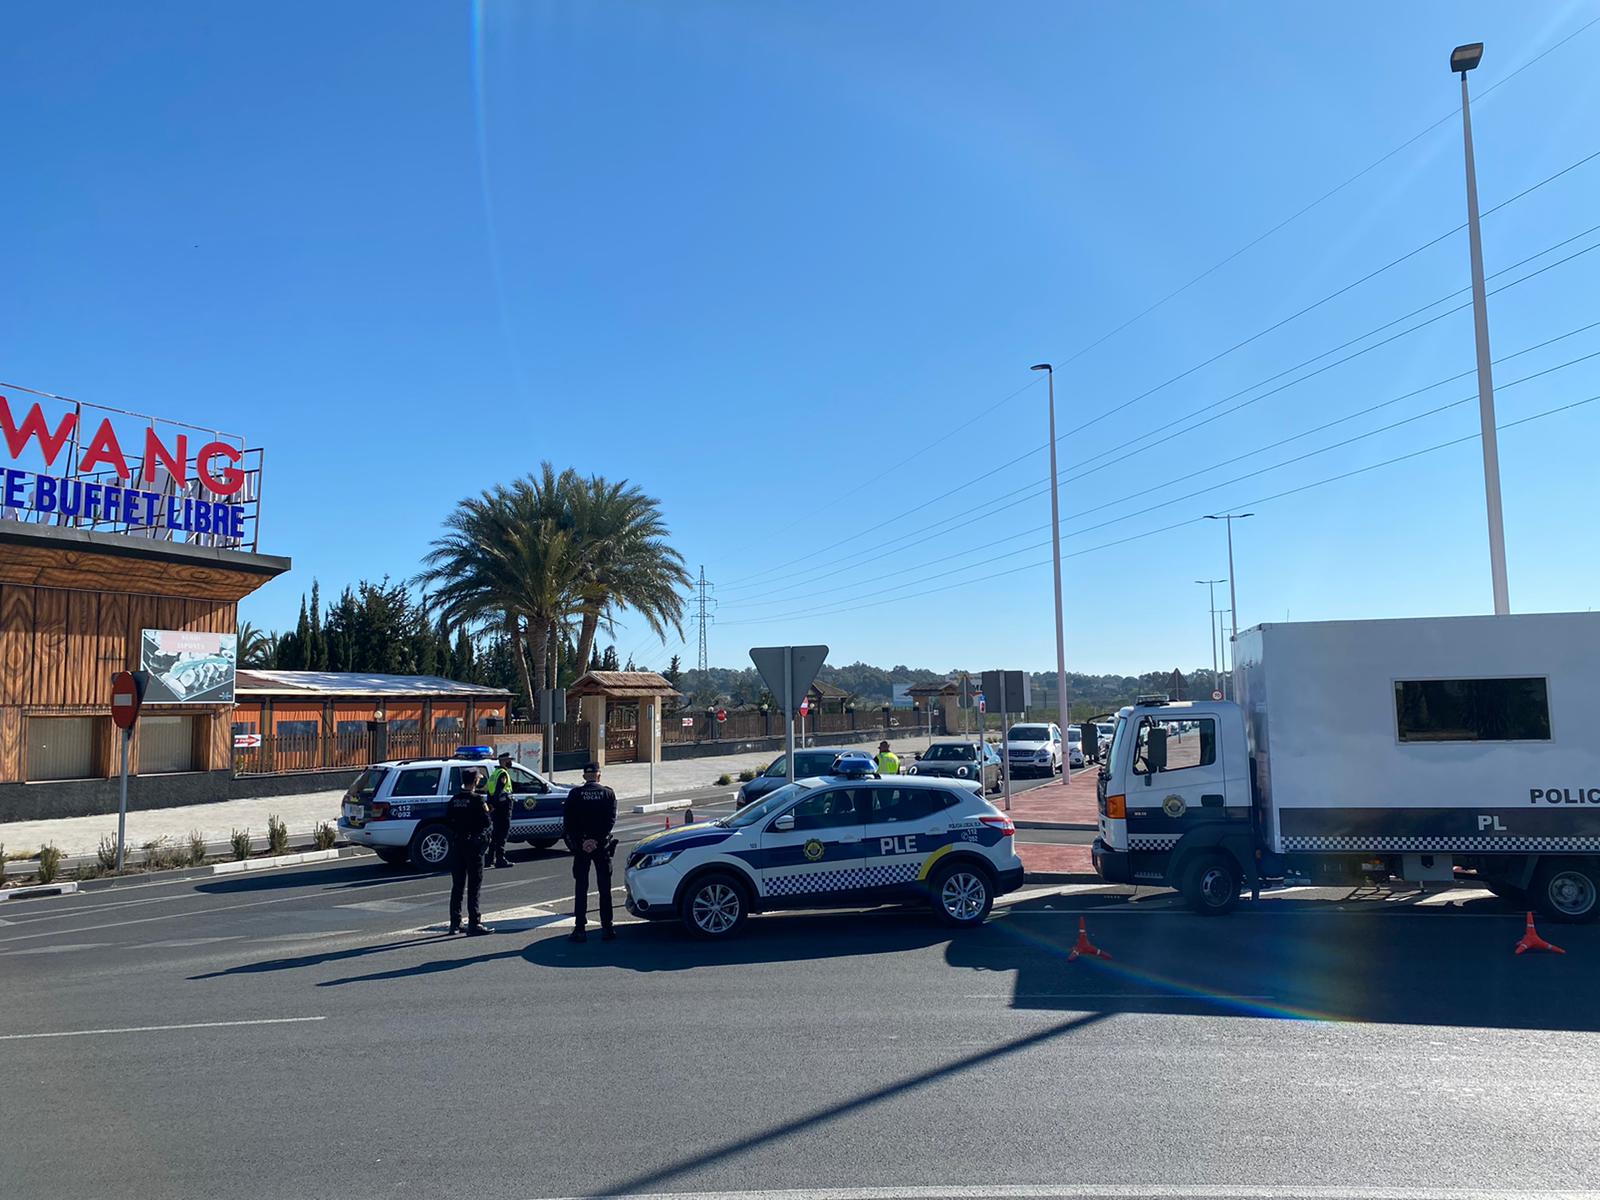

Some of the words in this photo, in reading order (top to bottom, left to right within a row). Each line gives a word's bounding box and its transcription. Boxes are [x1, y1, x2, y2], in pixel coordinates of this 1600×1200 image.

[0, 396, 245, 495] WANG
[35, 476, 160, 526] BUFFET
[166, 495, 245, 538] LIBRE
[1530, 788, 1600, 804] POLIC
[1477, 815, 1507, 830] PL
[880, 836, 917, 855] PLE
